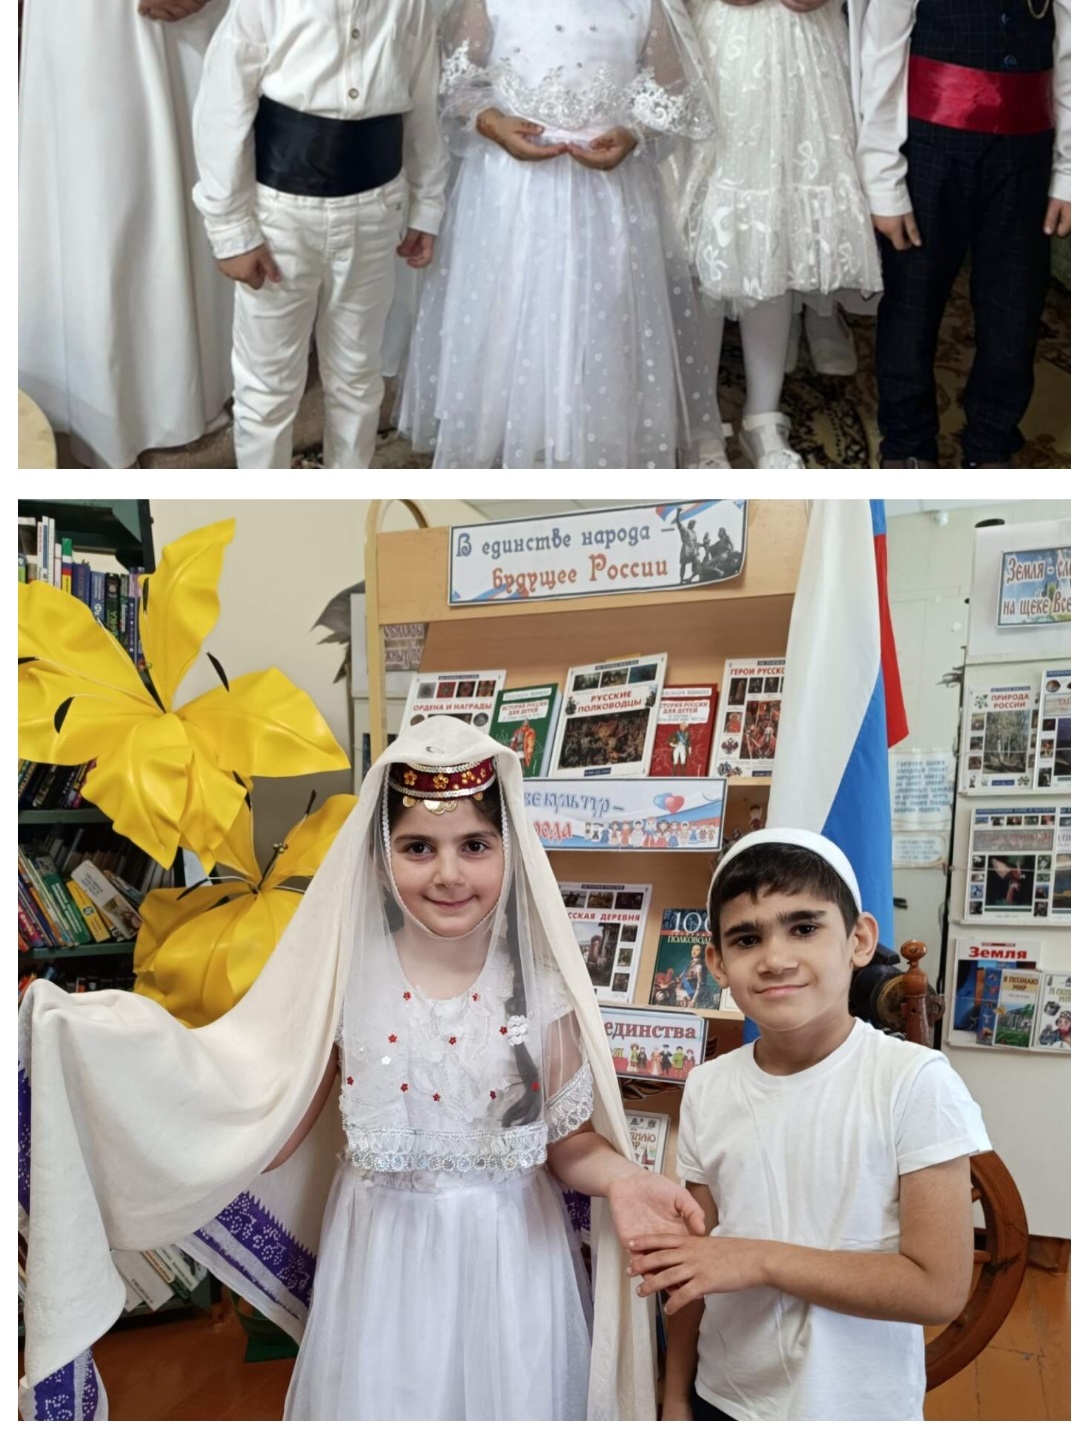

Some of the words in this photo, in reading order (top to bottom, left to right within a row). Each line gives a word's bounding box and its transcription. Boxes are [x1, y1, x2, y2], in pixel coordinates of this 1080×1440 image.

[456, 533, 473, 559] В
[482, 526, 571, 559] единстве
[581, 525, 651, 549] народа
[492, 565, 578, 594] будущее
[588, 553, 669, 583] России
[1006, 558, 1045, 584] Земля
[1003, 600, 1016, 616] на
[1020, 596, 1050, 618] щеке
[1052, 591, 1071, 614] Все
[730, 668, 755, 676] ГЕРОИ
[591, 690, 633, 702] РУССКИЕ
[991, 693, 1030, 702] ПРИРОДА
[413, 704, 444, 712] ОРДЕНА
[453, 702, 492, 711] НАГРАДЫ
[577, 699, 643, 714] ПОЛКОВОДЦЫ
[993, 701, 1026, 709] РОССИИ
[568, 913, 596, 921] ССКАЯ
[600, 913, 640, 921] ДЕРЕВНЯ
[968, 946, 1028, 959] Земля
[604, 1017, 697, 1039] единства
[630, 1132, 656, 1143] ЗНАЮ
